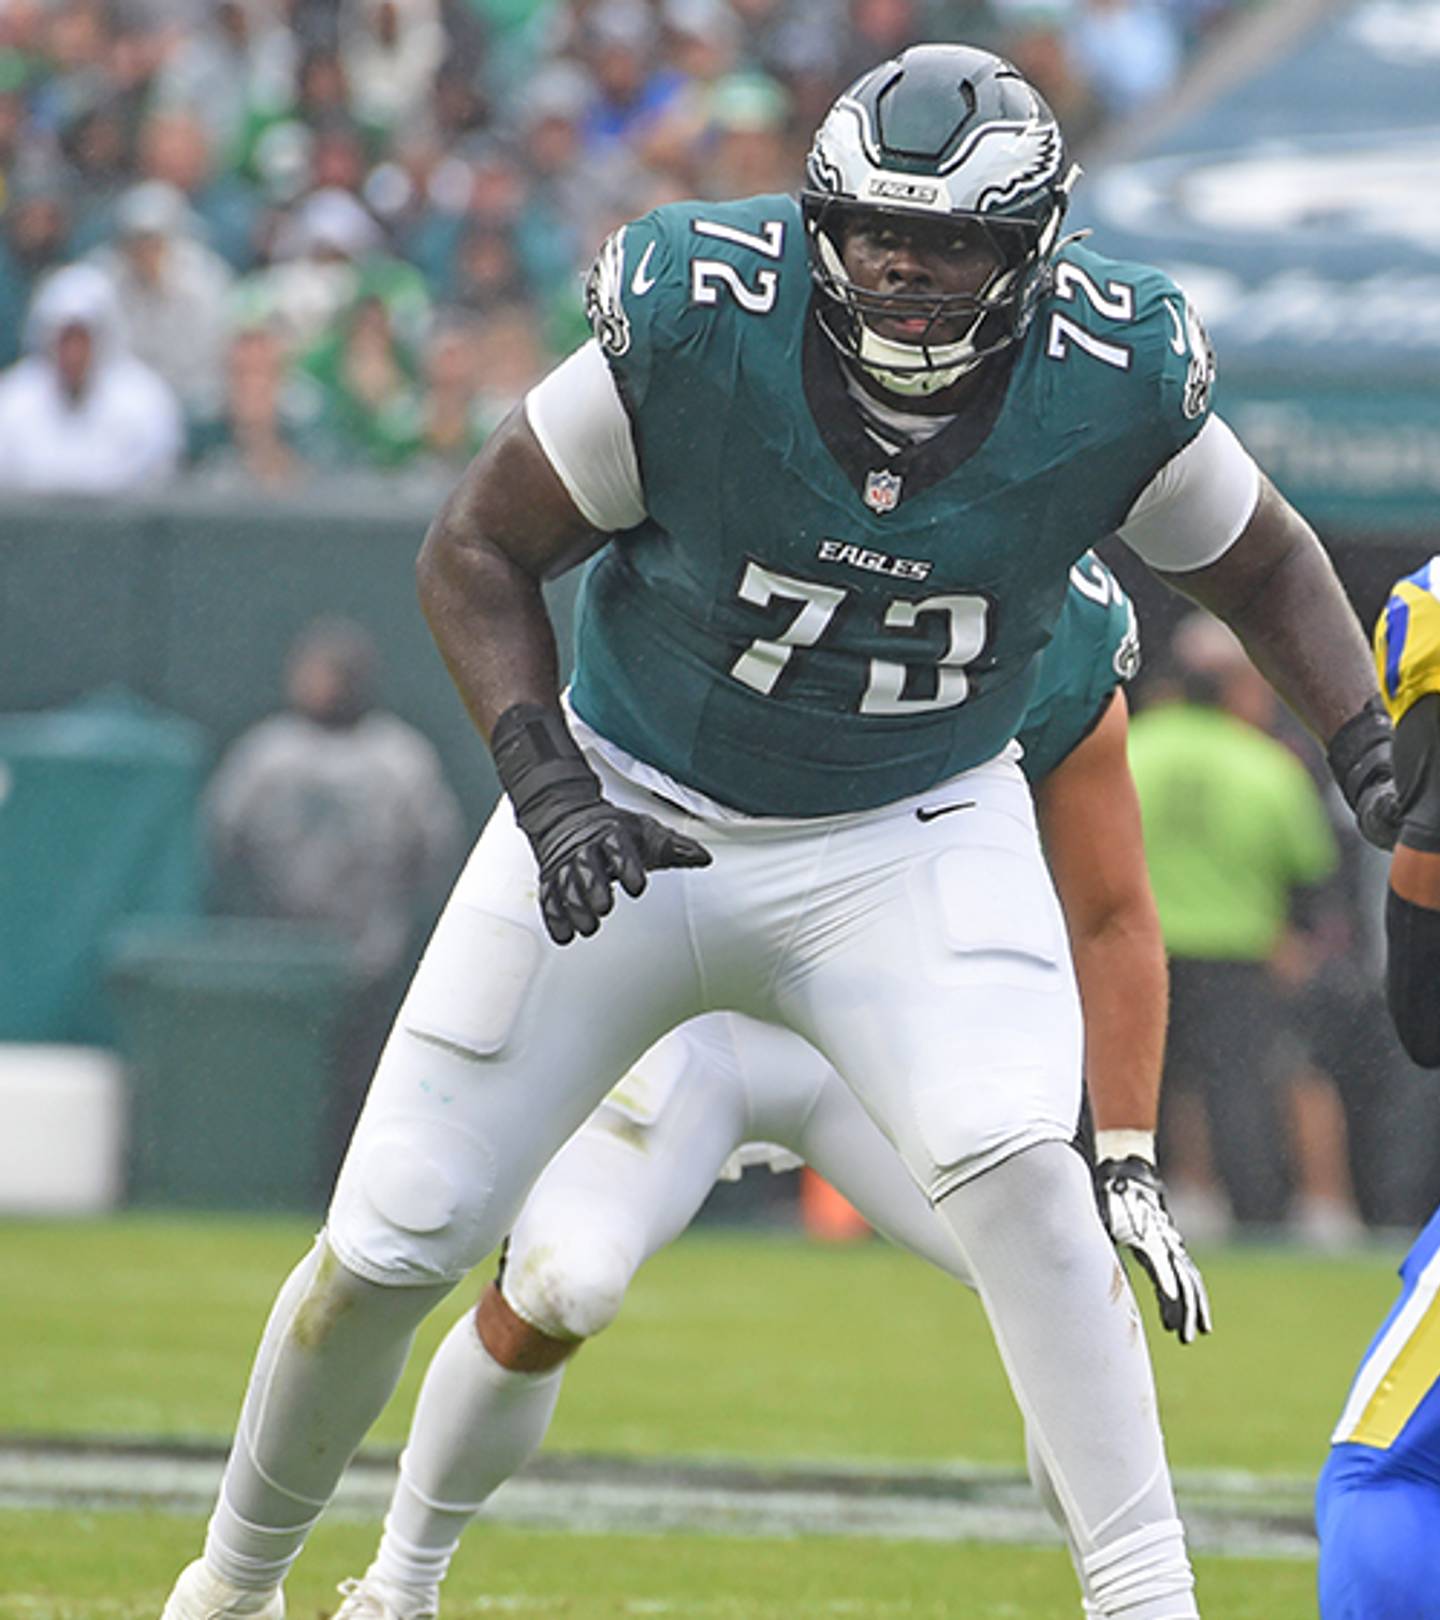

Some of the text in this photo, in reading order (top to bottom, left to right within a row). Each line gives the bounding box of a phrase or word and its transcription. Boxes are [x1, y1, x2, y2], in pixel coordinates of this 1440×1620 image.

[693, 218, 783, 313] 72
[1048, 261, 1133, 369] 72
[817, 540, 935, 582] EAGLES
